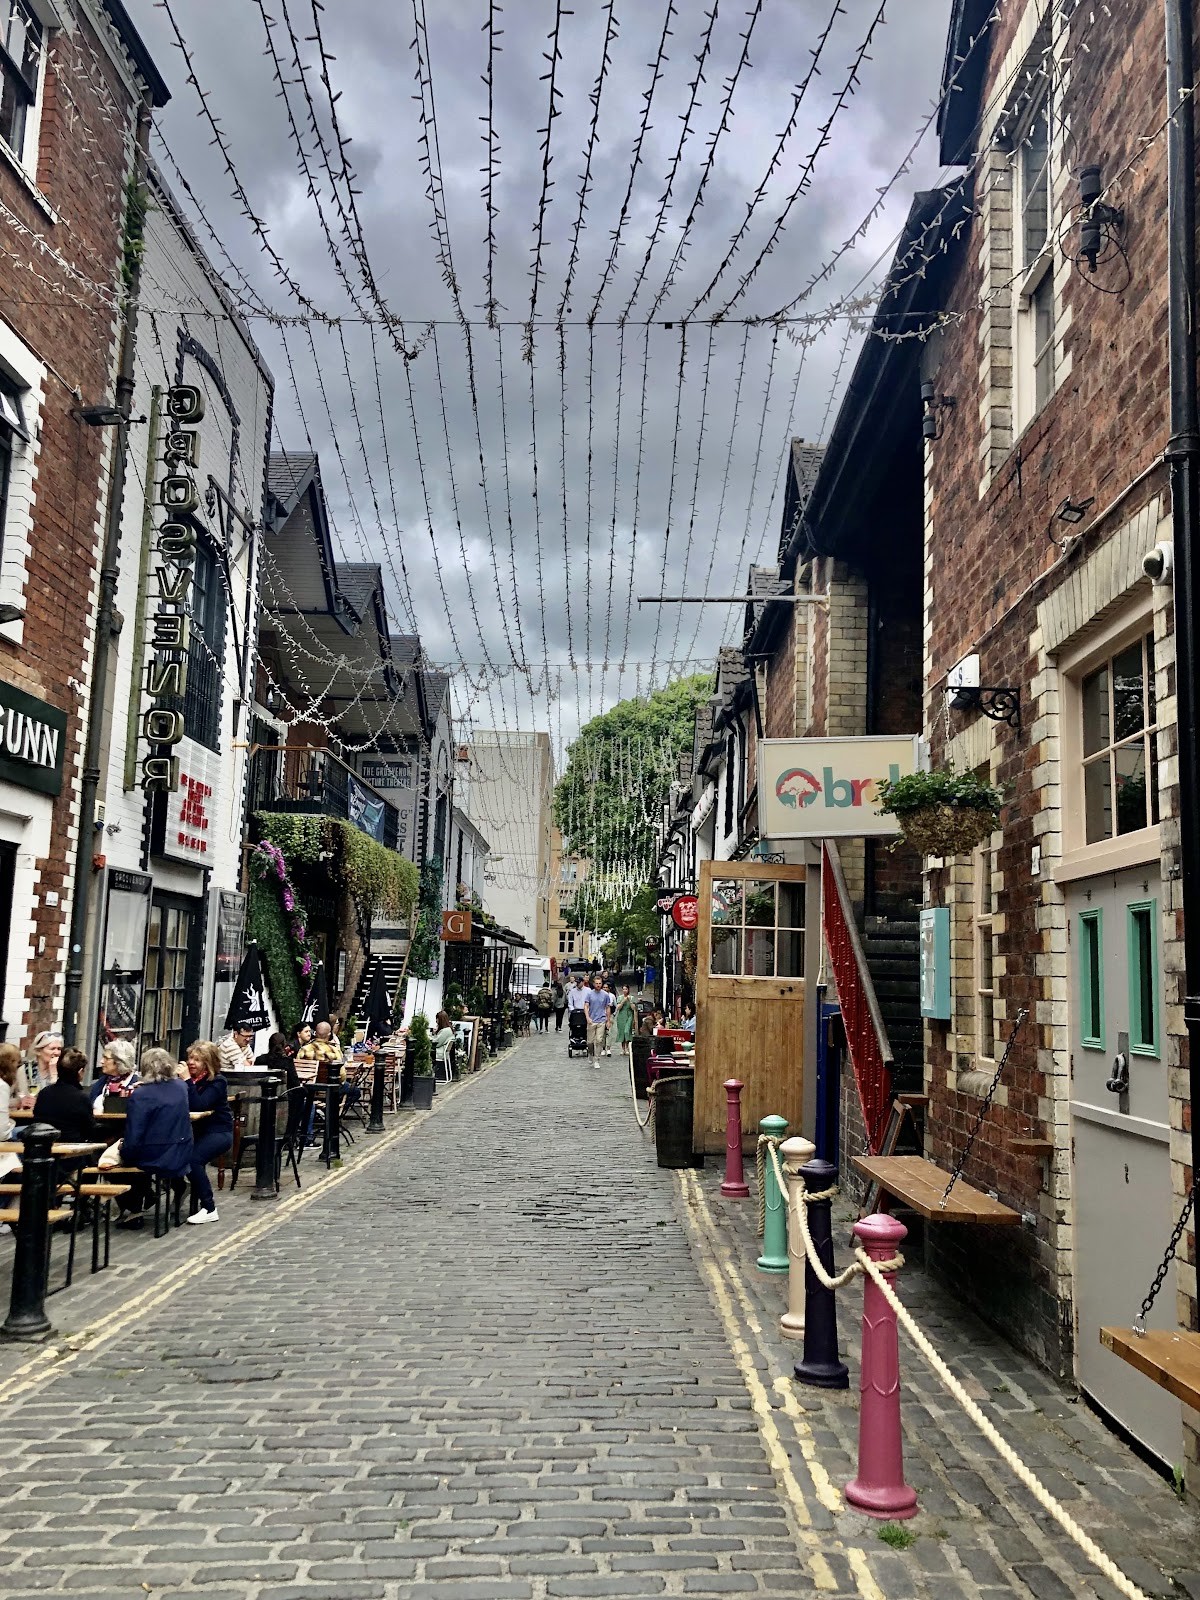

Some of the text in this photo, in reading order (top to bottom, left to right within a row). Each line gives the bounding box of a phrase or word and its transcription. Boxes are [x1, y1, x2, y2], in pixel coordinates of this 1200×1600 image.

[363, 767, 411, 777] THE GROSVENOR
[363, 777, 411, 788] CTURE THEATRE
[447, 914, 465, 934] G
